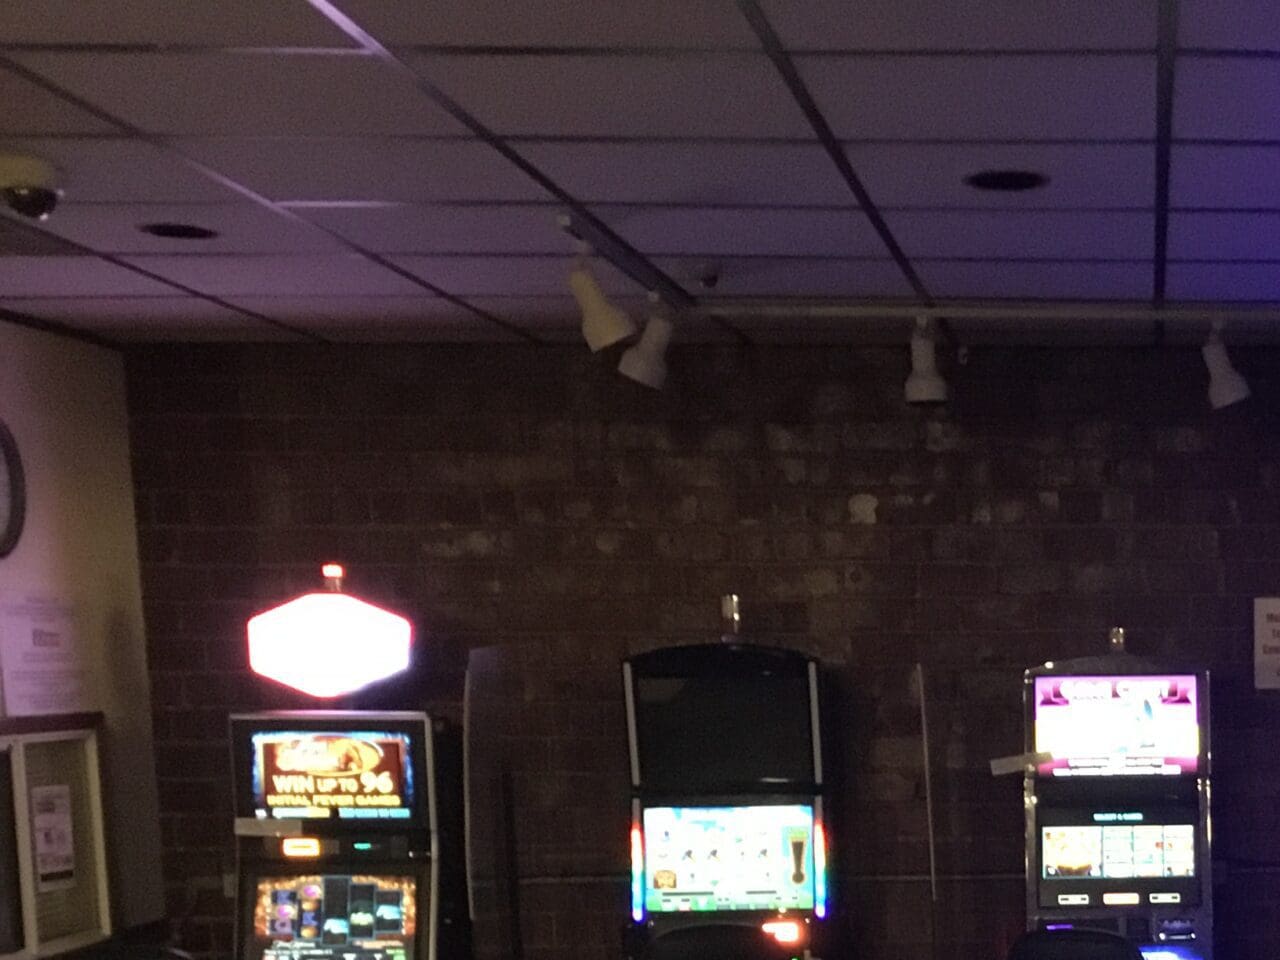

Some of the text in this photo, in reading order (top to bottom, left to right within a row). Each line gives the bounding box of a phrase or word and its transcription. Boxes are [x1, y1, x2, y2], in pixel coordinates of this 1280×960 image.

[272, 771, 394, 794] WIN UP TO 96
